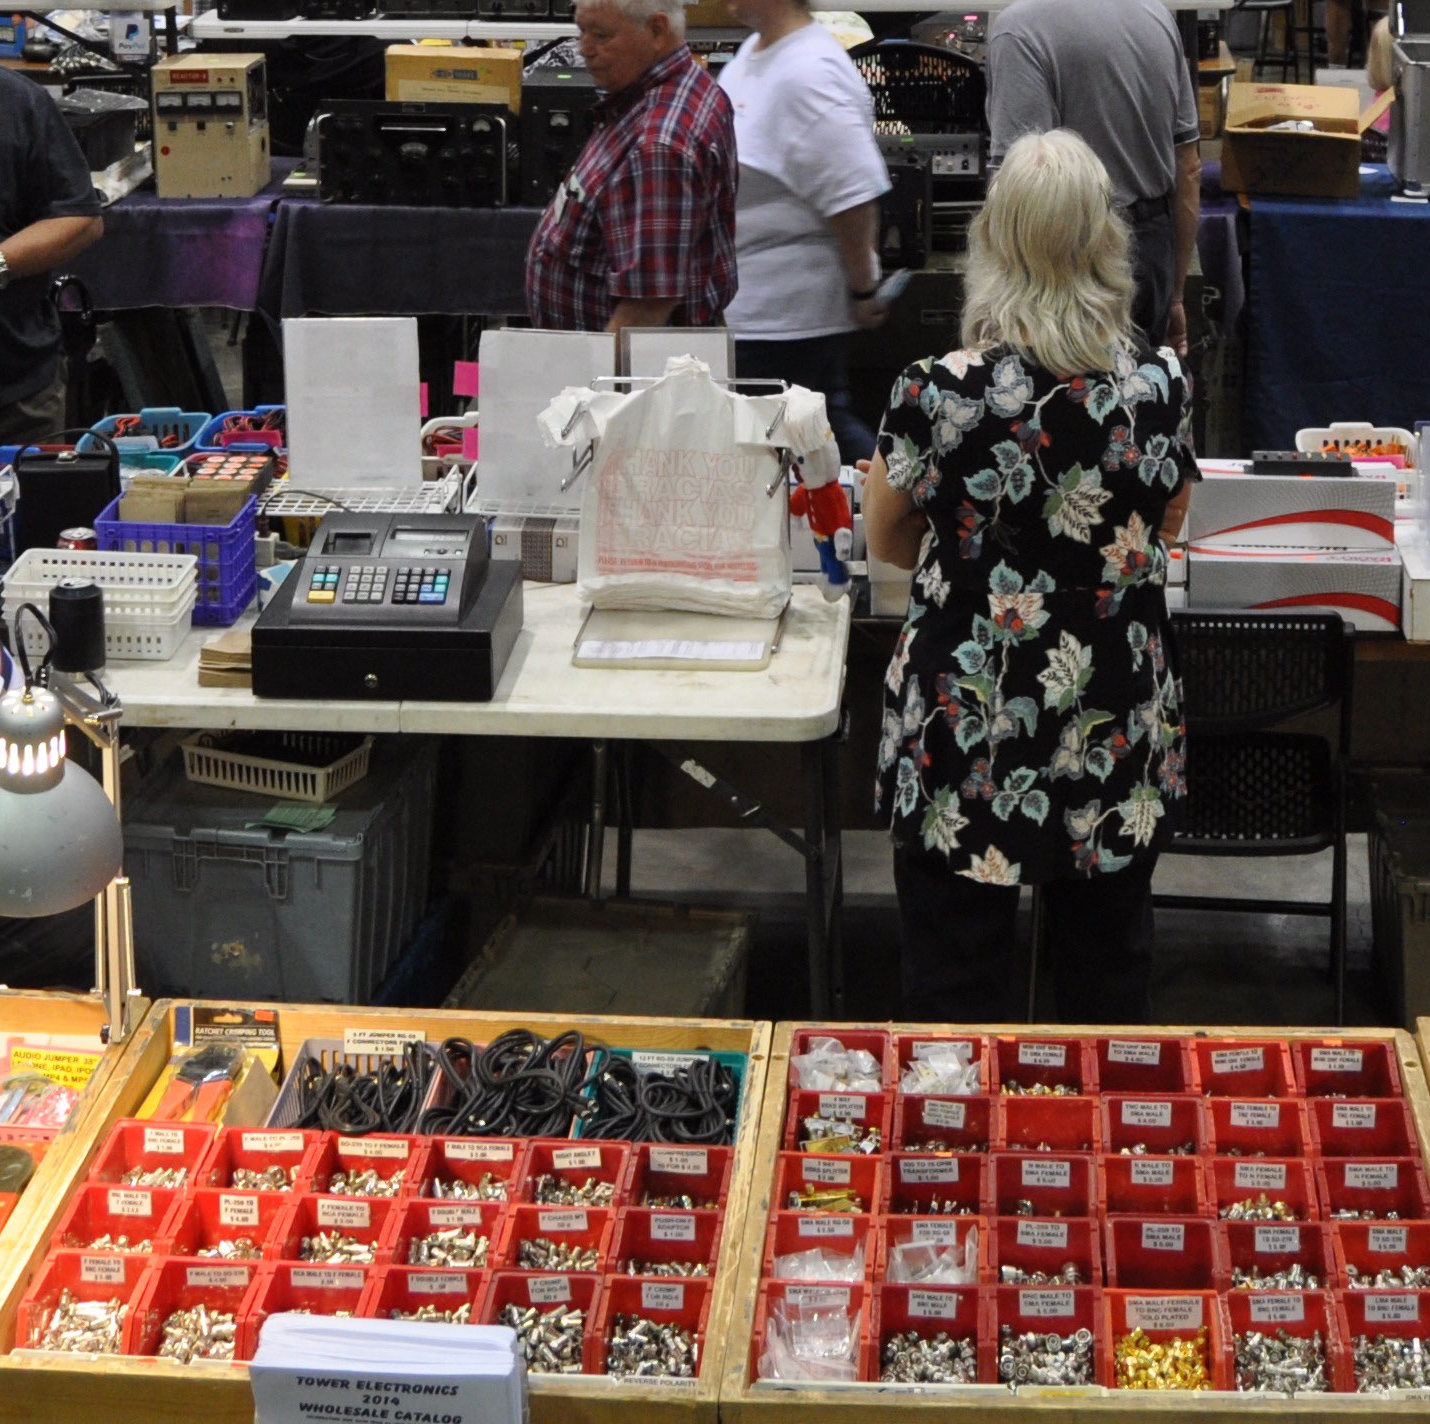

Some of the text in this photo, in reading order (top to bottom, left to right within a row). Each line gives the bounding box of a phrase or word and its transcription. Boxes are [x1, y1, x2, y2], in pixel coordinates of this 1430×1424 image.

[702, 452, 755, 483] YOU
[703, 503, 754, 530] YOU
[195, 1027, 275, 1037] RATCHET CRIMPING TOOL
[14, 1051, 40, 1059] AUDIO
[42, 1054, 80, 1064] JUMPER
[296, 1376, 459, 1396] TOWER ELECTRONICS
[624, 1378, 696, 1387] REVERSE POLARITY
[363, 1395, 400, 1406] 2014
[299, 1402, 462, 1424] WHOLESALE CATALOG
